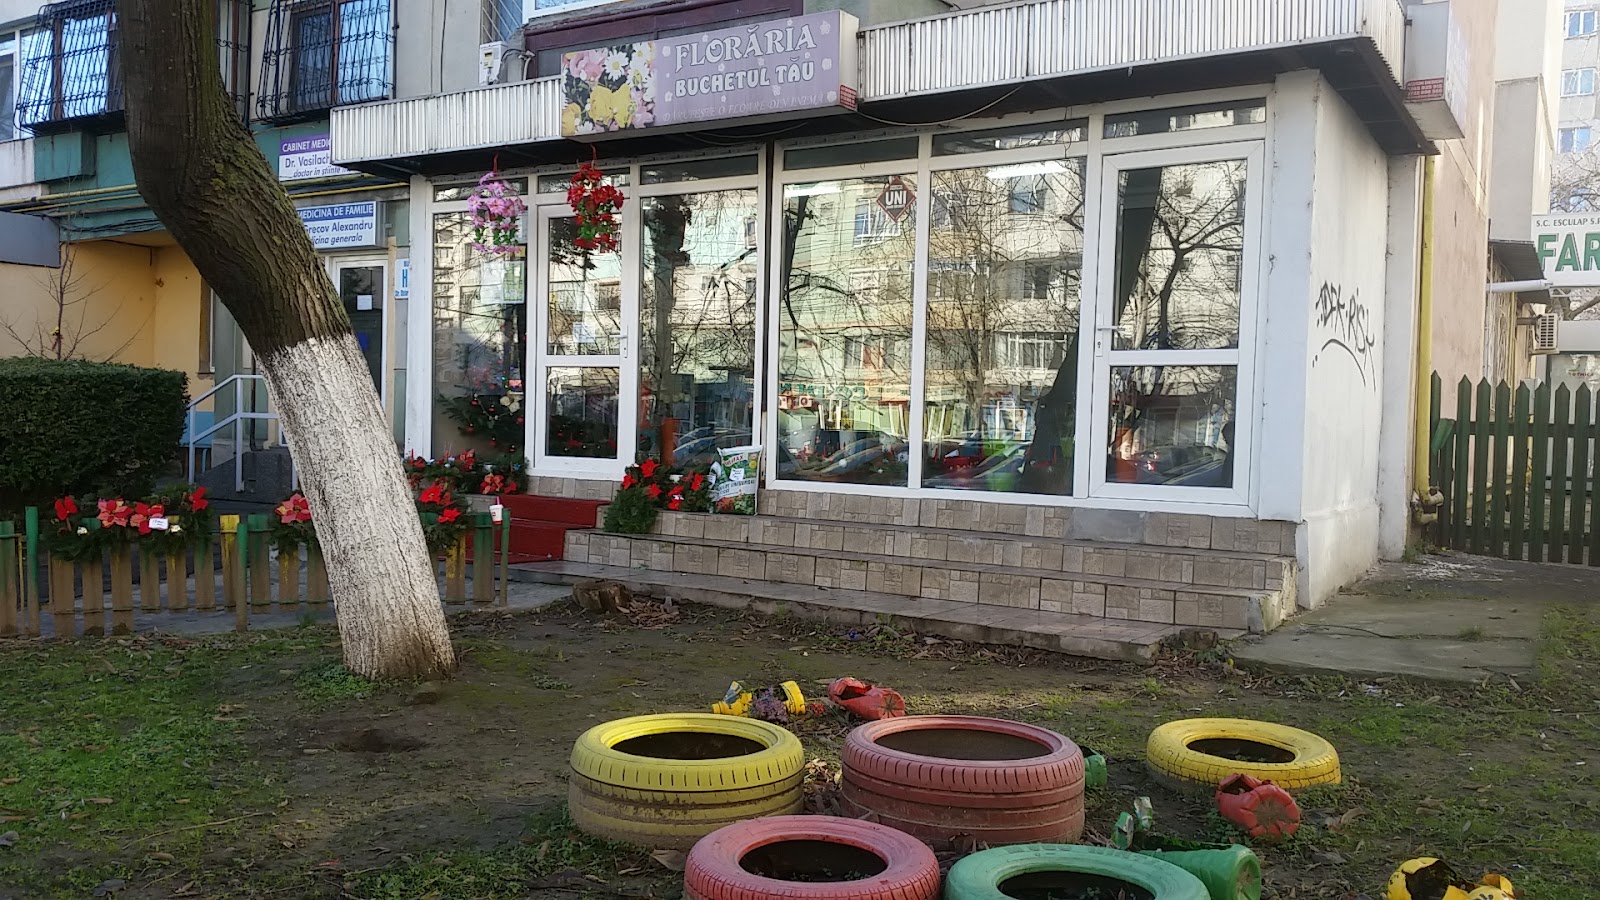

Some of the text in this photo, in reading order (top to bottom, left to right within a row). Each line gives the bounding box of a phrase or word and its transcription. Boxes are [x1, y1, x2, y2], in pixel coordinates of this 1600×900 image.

[675, 24, 817, 73] FLORĂRIA
[675, 56, 815, 98] BUCHETUL TĂU
[282, 142, 310, 152] CABINET
[285, 158, 296, 168] Dr.
[293, 169, 312, 178] doctor
[885, 190, 907, 206] UNI
[334, 206, 344, 215] DE
[345, 203, 373, 214] FAMILIE
[331, 220, 373, 232] Alexandru
[1536, 219, 1551, 227] S.C.
[1553, 218, 1588, 226] ESCULAP
[330, 233, 363, 246] generala
[1537, 232, 1600, 271] FAR
